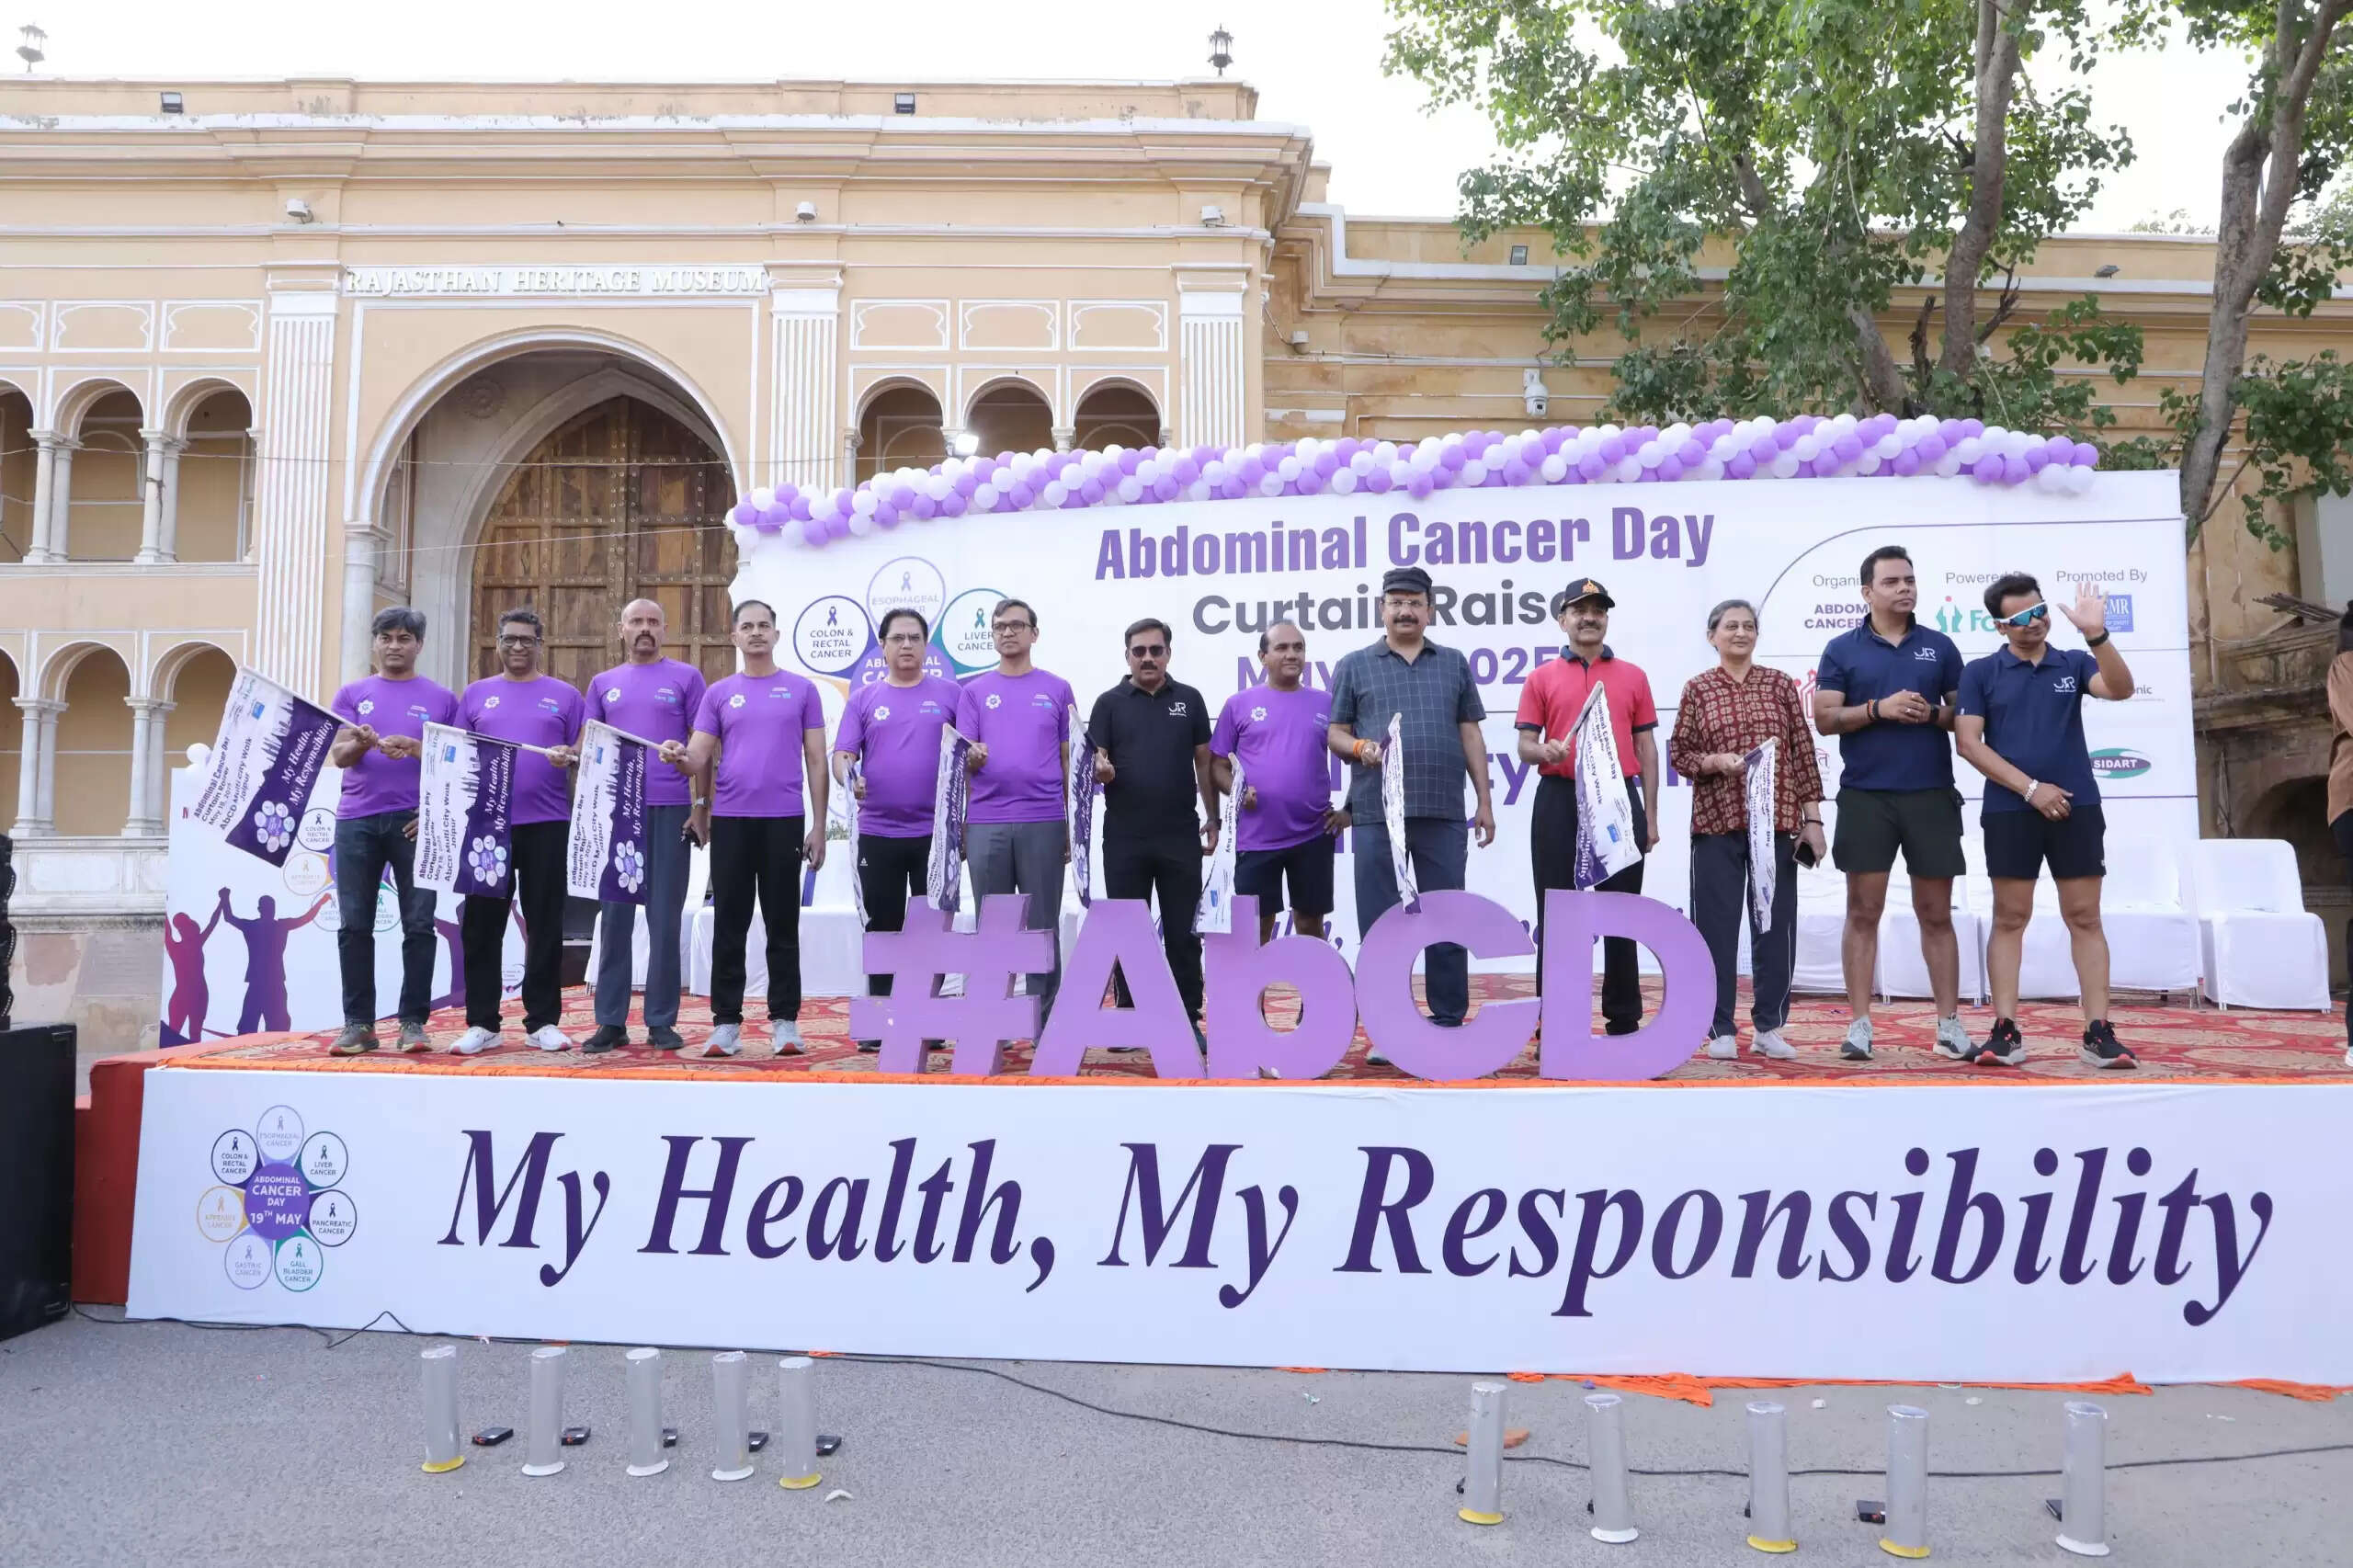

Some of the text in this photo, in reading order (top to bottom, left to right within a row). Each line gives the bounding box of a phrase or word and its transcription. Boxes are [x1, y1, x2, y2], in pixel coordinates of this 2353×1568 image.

[346, 270, 768, 296] RAJASTHAN HERITAGE MUSEUM
[1095, 506, 1715, 581] Abdominal Cancer Day
[2056, 569, 2148, 584] Promoted By
[871, 595, 939, 606] ESOPHAGEAL
[810, 628, 854, 638] COLON &
[964, 631, 994, 641] LIVER
[813, 640, 851, 648] RECTAL
[957, 642, 994, 651] CANCE
[810, 649, 852, 659] CANCER
[288, 719, 334, 805] My Responsibility
[2094, 759, 2138, 768] SIDART
[279, 765, 298, 784] My
[220, 803, 238, 830] AbCD
[240, 737, 253, 760] Walk
[484, 756, 500, 814] My Health,
[1593, 778, 1604, 805] Walk
[592, 784, 600, 810] Walk
[200, 791, 222, 823] Curtain
[621, 800, 632, 819] My
[442, 808, 450, 827] City
[493, 815, 506, 832] My
[632, 820, 643, 837] My
[850, 889, 1717, 1081] #AbCD
[252, 1185, 301, 1196] CANCER
[267, 1198, 285, 1207] DAY
[276, 1213, 301, 1225] MAY
[313, 1220, 352, 1228] PANCREATIC
[437, 1130, 2274, 1327] My Health, My Responsibility
